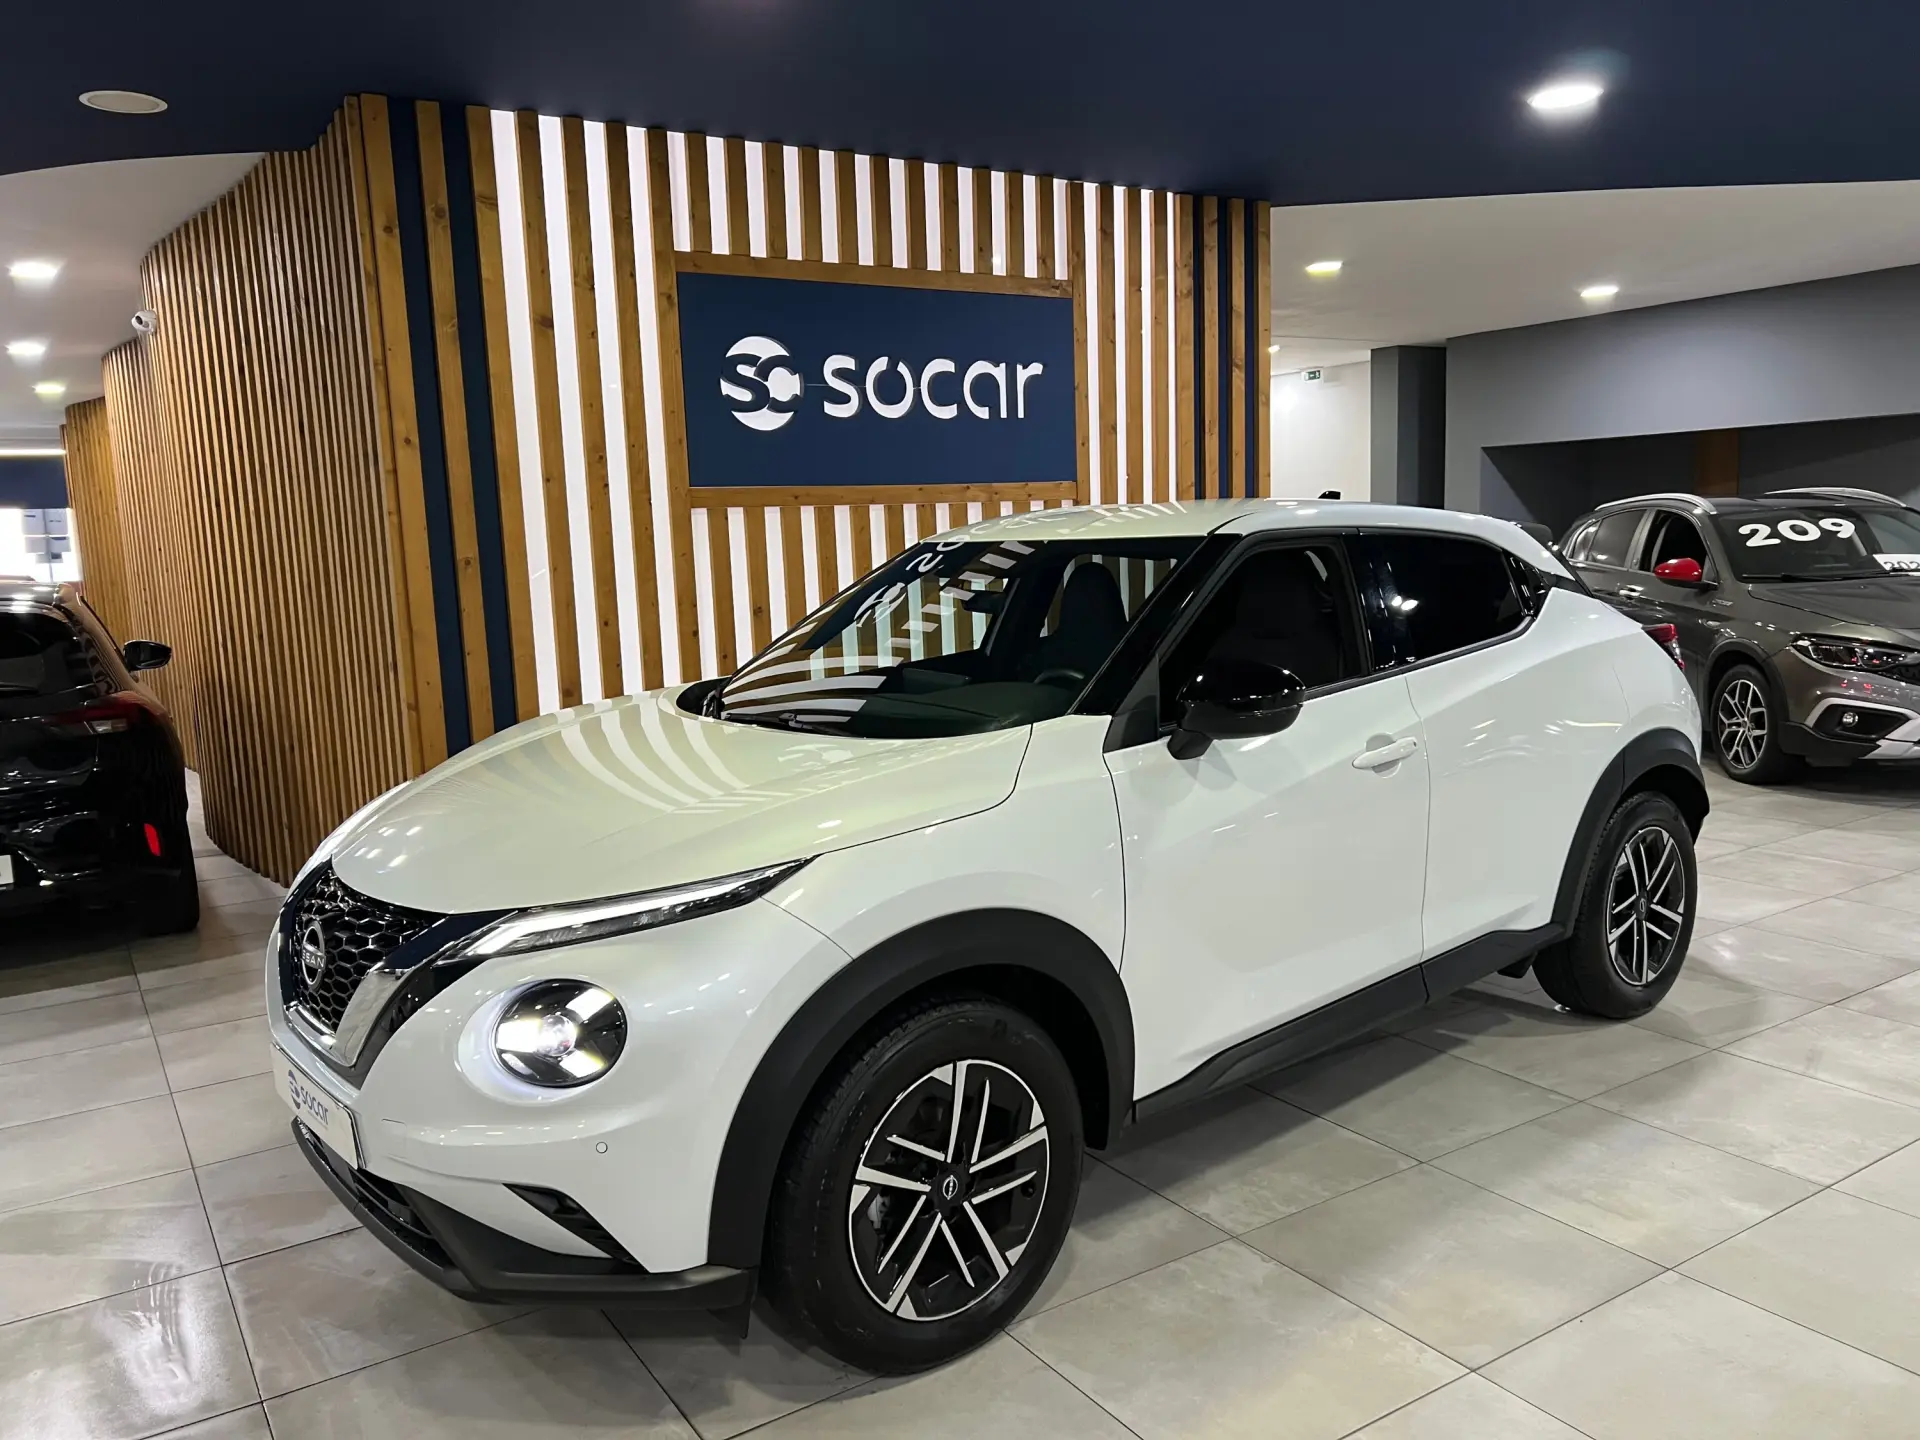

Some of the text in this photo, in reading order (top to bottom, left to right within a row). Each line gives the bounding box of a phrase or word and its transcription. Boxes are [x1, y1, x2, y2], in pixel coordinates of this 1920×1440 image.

[823, 354, 1044, 419] socar
[1738, 517, 1856, 547] 209
[300, 1086, 329, 1126] socar
